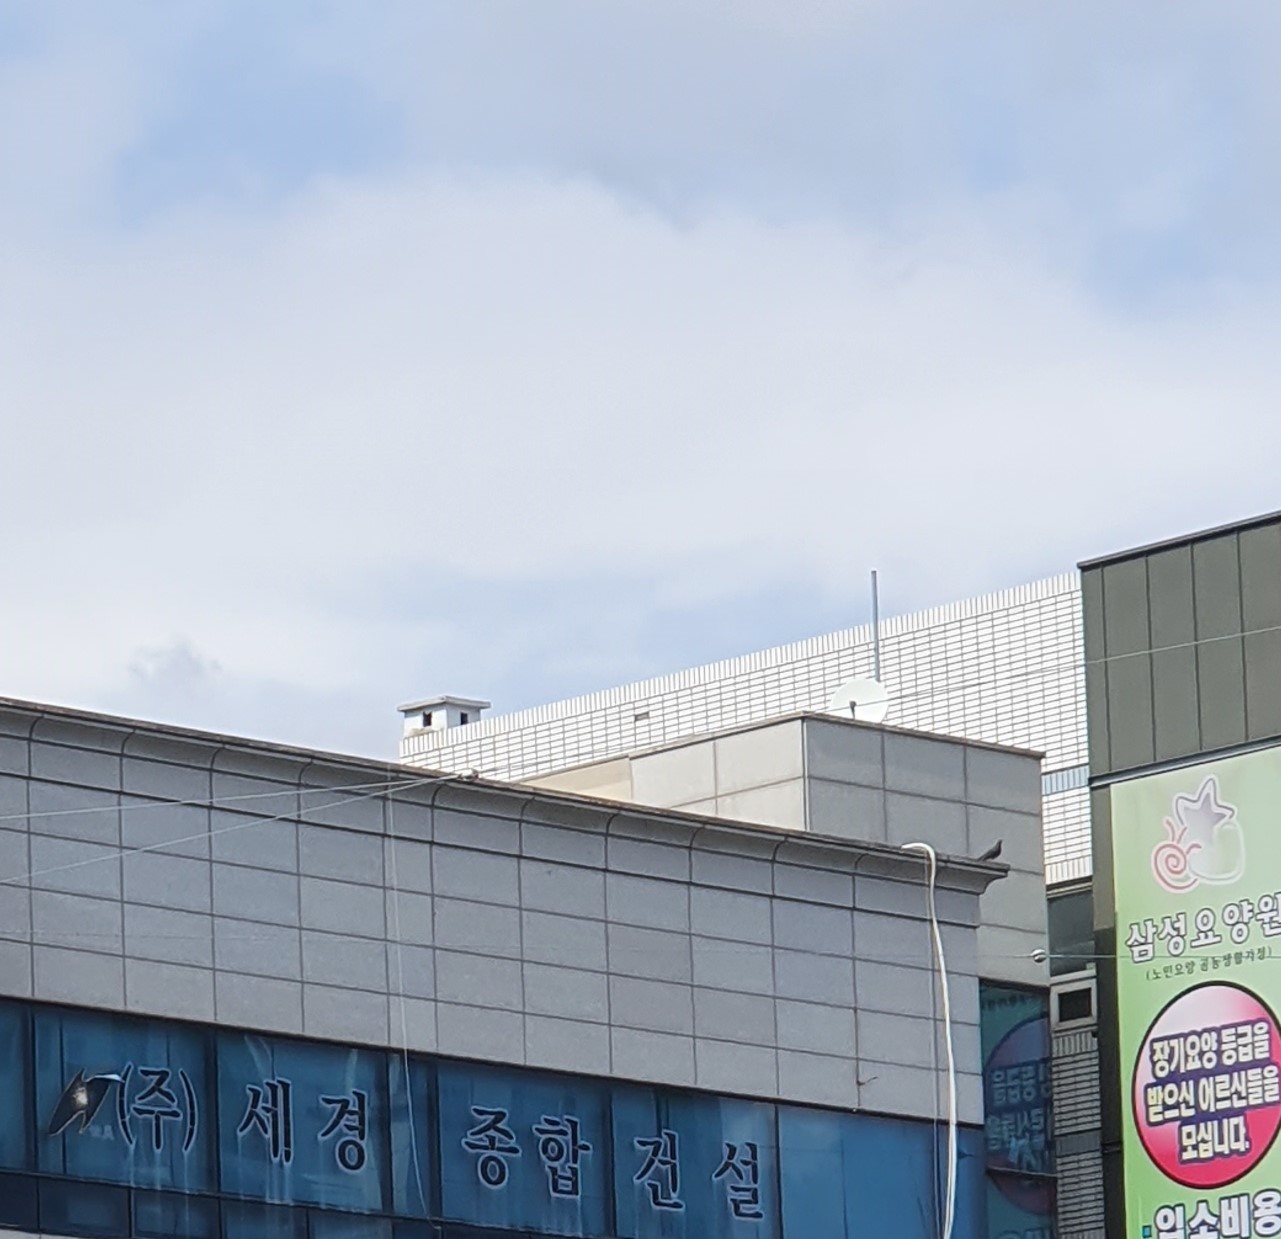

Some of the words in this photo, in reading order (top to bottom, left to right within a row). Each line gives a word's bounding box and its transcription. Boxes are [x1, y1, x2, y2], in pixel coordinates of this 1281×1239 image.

[1151, 1030, 1218, 1080] 장기요양
[1220, 1021, 1270, 1066] 등급을
[1147, 1078, 1196, 1123] 받으신
[1198, 1064, 1280, 1115] 어르신들을
